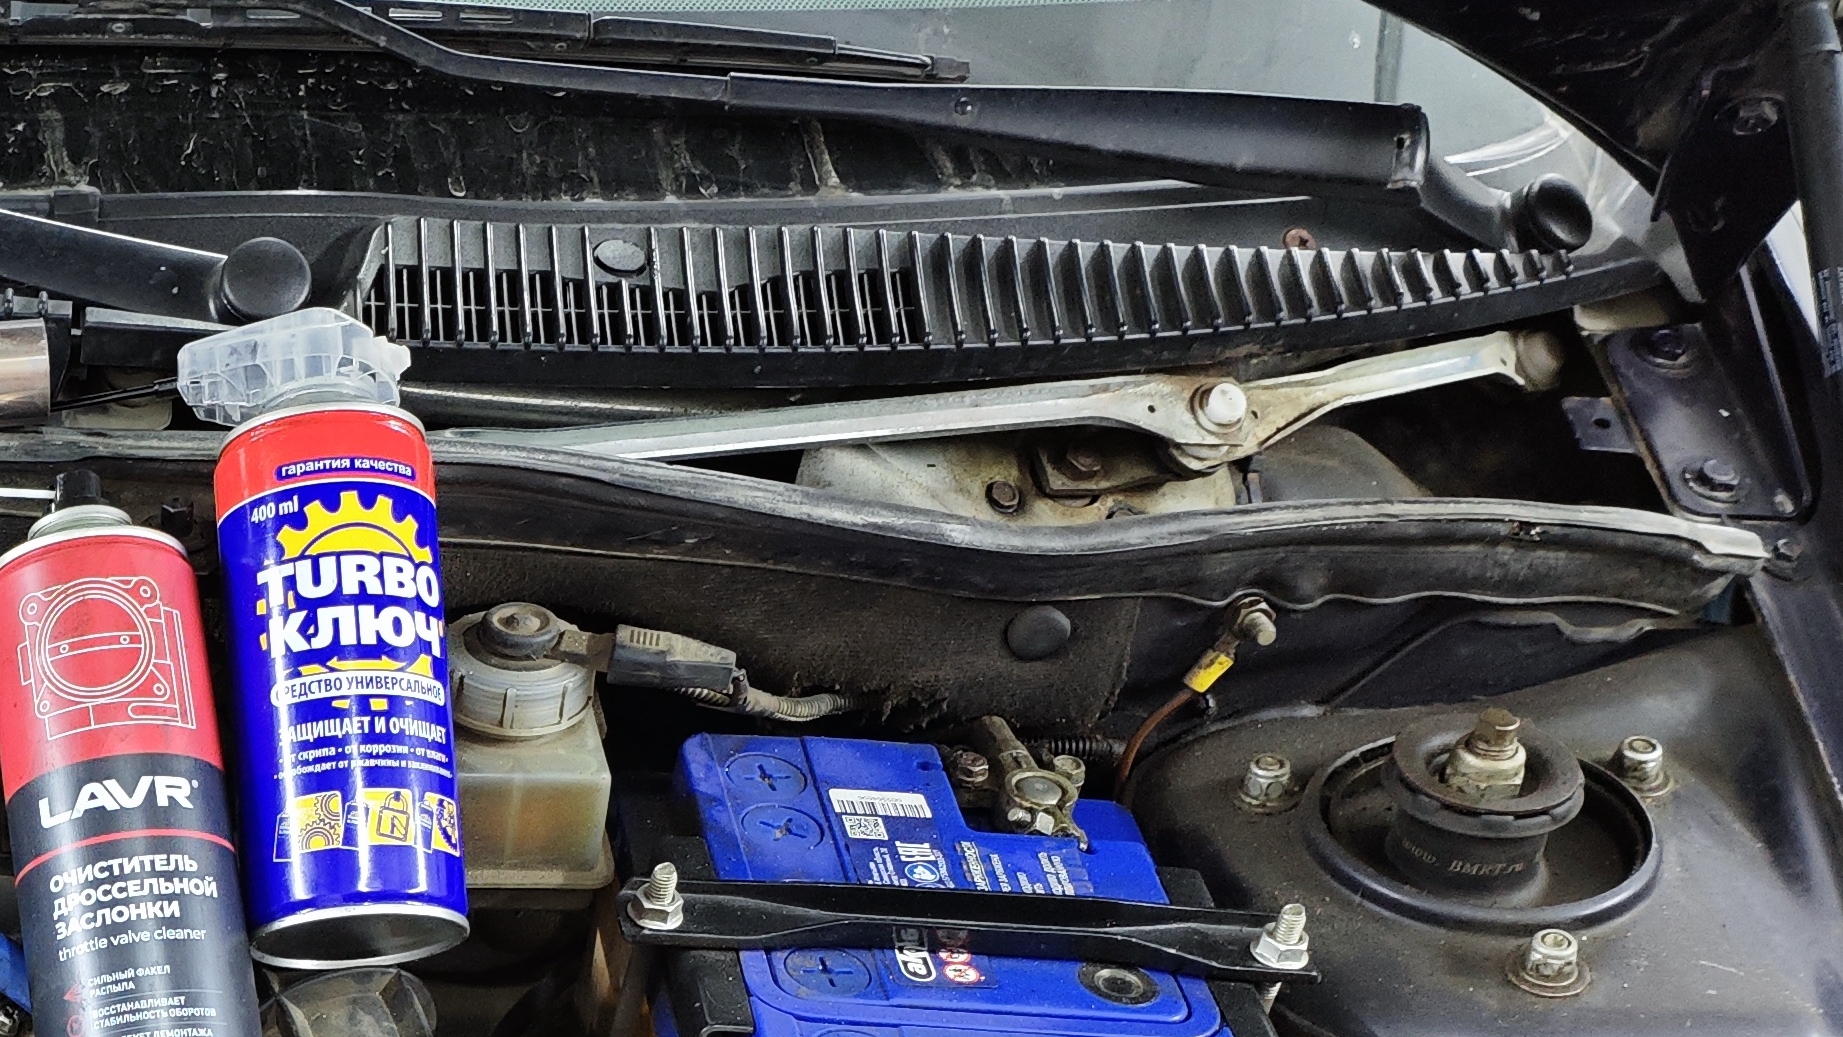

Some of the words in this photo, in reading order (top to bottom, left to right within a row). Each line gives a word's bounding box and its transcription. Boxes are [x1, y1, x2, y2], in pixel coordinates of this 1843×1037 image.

[281, 458, 350, 477] гарантия
[354, 458, 412, 477] качества
[250, 504, 276, 524] 400
[278, 495, 299, 516] ml
[257, 554, 440, 609] TURBO
[269, 604, 441, 658] КЛЮЧ
[275, 676, 342, 701] РЕДСТВО
[346, 675, 442, 701] УНИВЕРСАЛЬНОЕ
[279, 716, 371, 746] АЩИЩАЕТ
[374, 716, 387, 734] И
[389, 716, 447, 745] ОЧИЩАЕТ
[298, 746, 335, 763] скрипа
[344, 745, 357, 755] от
[359, 744, 408, 756] коррозии
[338, 759, 349, 770] от
[38, 775, 194, 829] LAVR
[49, 854, 199, 893] ОЧИСТИТЕЛЬ
[52, 876, 219, 920] ДРОССЕЛЬНОЙ
[55, 900, 181, 940] ЗАСЛОНКИ
[58, 936, 108, 962] throttle
[110, 929, 151, 947] valve
[153, 926, 207, 941] cleaner
[87, 967, 135, 988] СИЛЬНЫЙ
[136, 964, 171, 977] ФАКЕЛ
[89, 980, 136, 999] РАСПЫЛА
[92, 996, 186, 1019] ВОССТАНАВЛИВАЕТ
[93, 1008, 168, 1030] СТАБИЛЬНОСТЬ
[169, 1007, 217, 1018] ОБОРОТОВ
